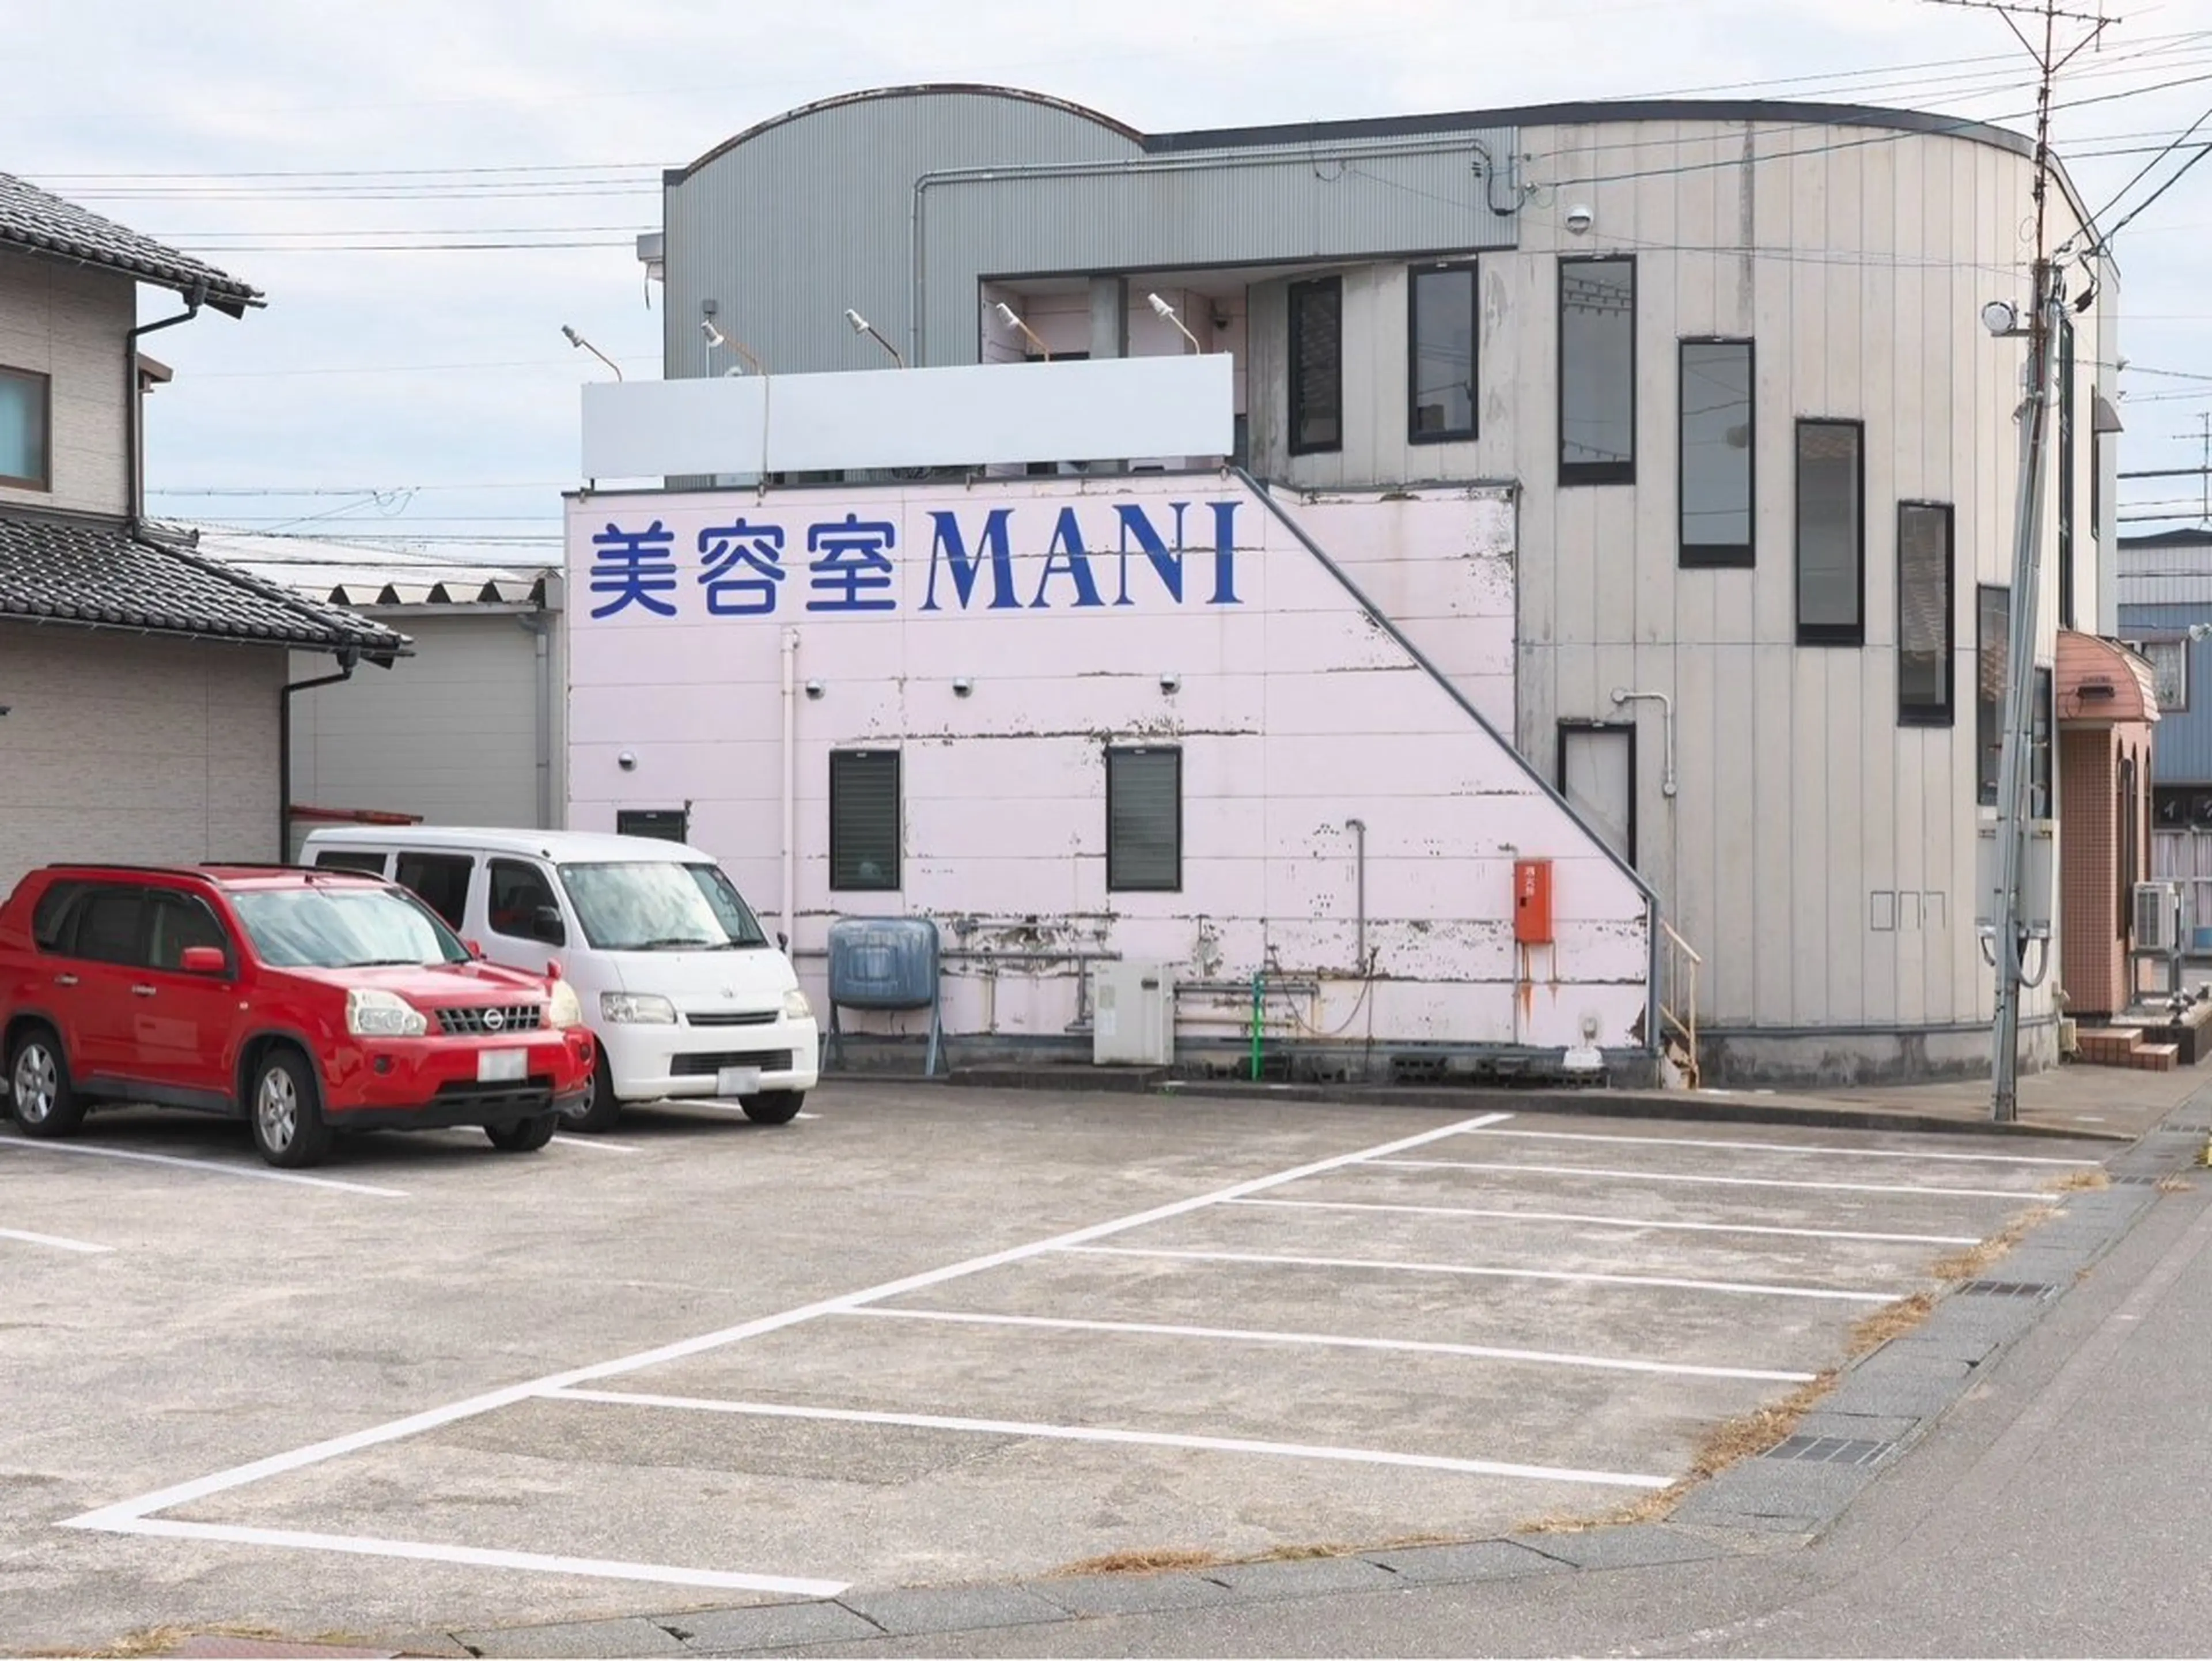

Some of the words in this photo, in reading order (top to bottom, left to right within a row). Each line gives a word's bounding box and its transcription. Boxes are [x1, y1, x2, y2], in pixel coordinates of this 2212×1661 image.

[590, 513, 897, 619] 美容室
[919, 502, 1244, 610] MANI
